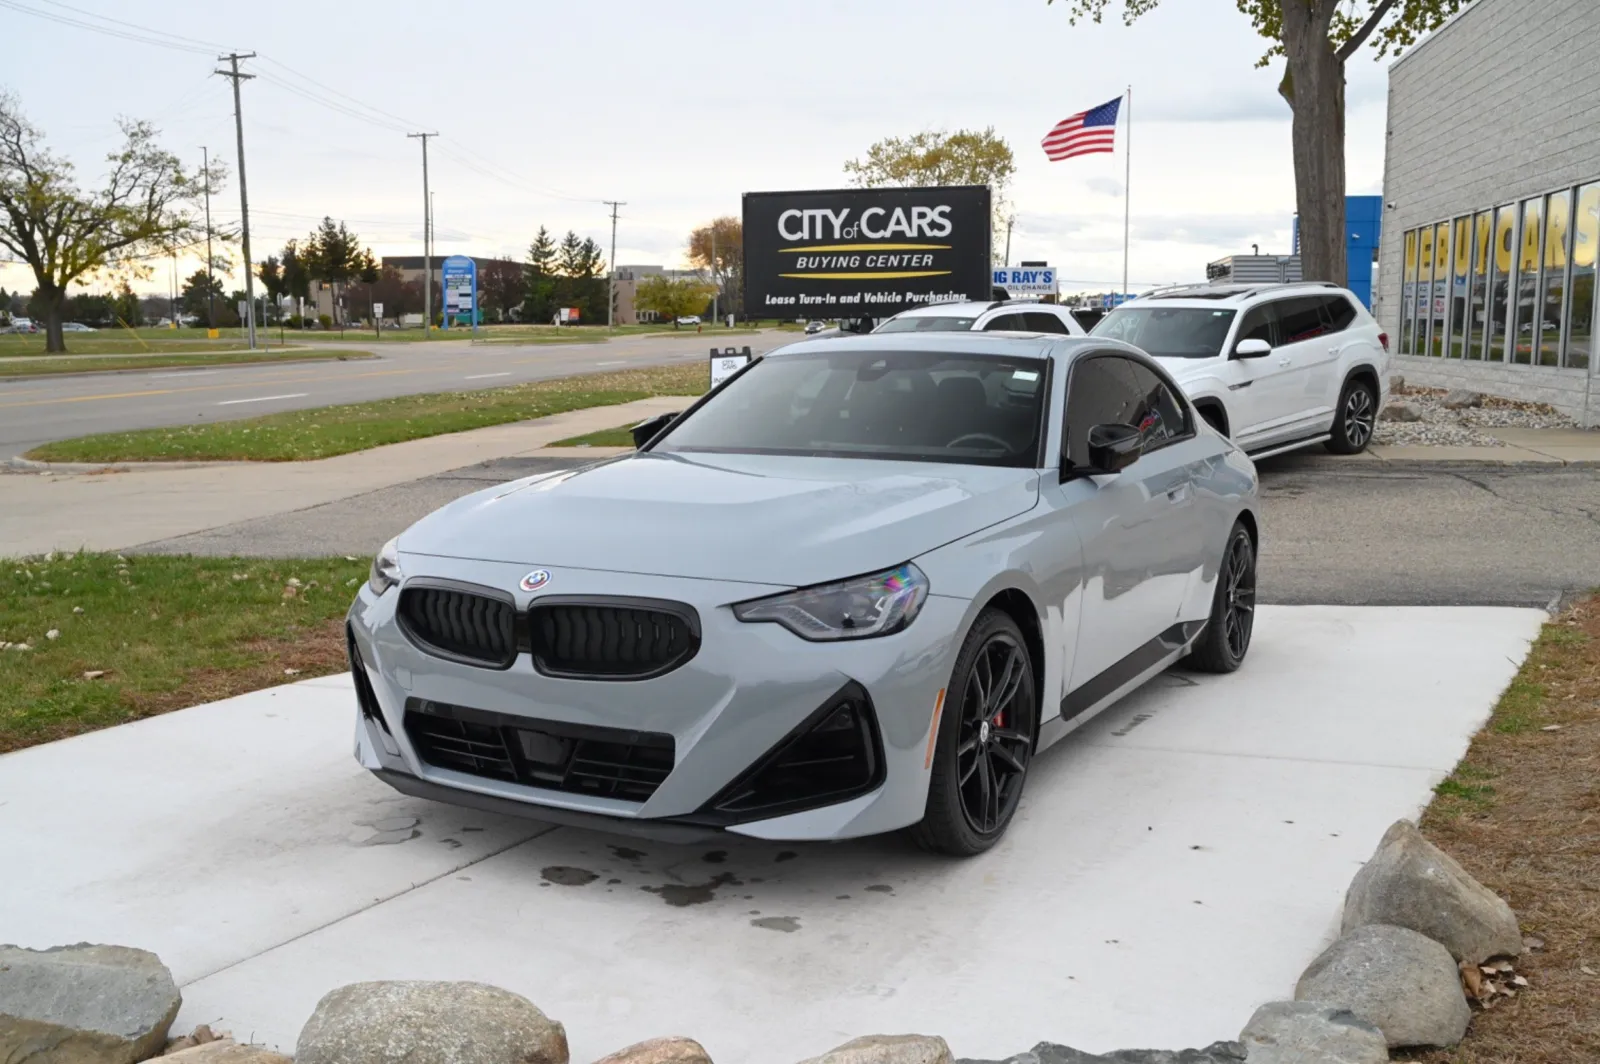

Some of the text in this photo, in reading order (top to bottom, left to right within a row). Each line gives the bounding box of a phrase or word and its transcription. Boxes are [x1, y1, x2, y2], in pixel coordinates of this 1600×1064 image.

[777, 205, 953, 241] CITY of CARS
[796, 254, 934, 269] BUYING CENTER
[993, 270, 1053, 284] IG RAY'S
[765, 294, 796, 305] Lease
[799, 293, 836, 304] Turn-In
[839, 292, 861, 304] and
[864, 291, 902, 304] Vehicle
